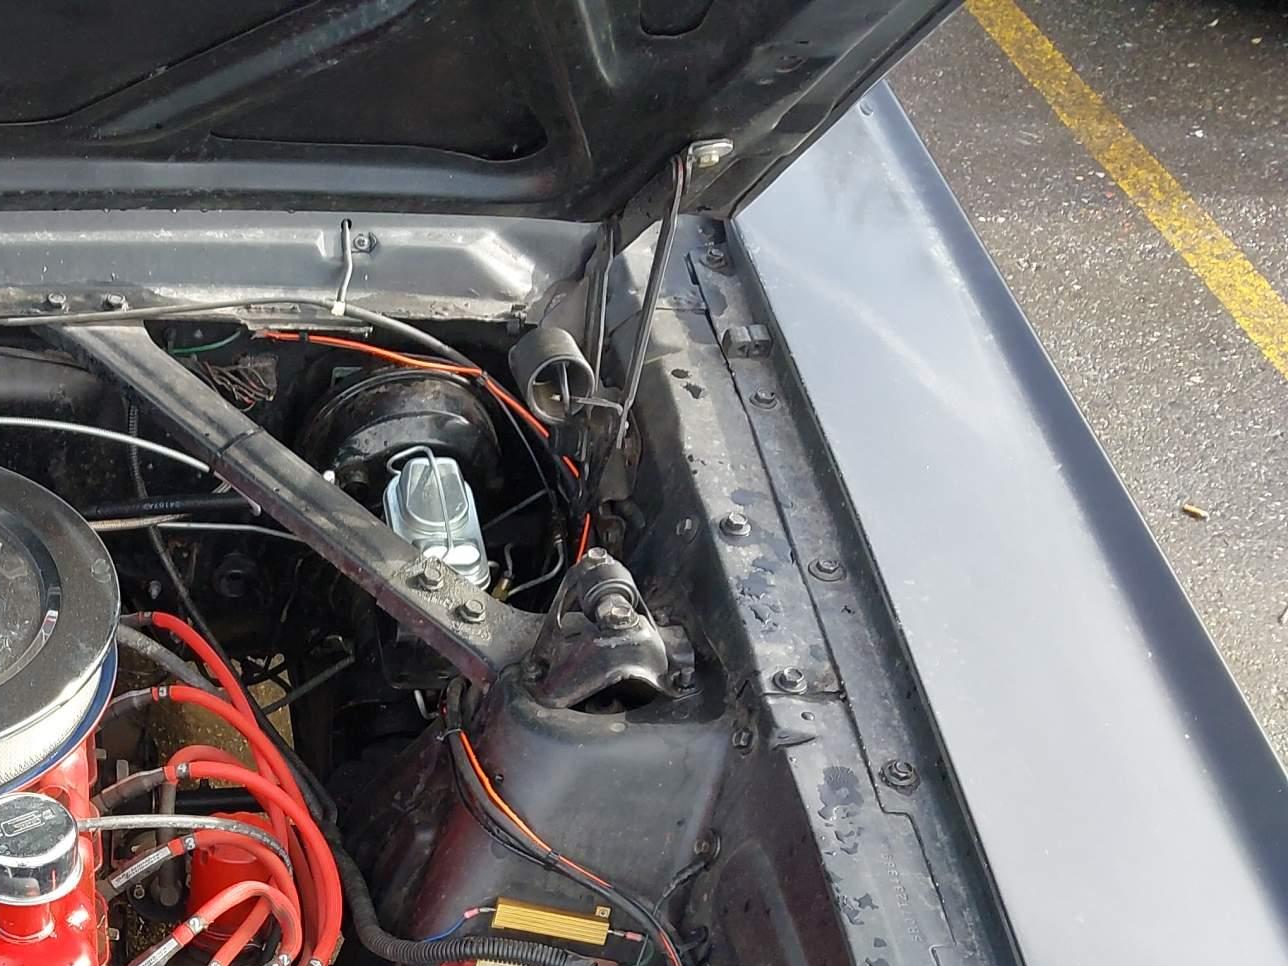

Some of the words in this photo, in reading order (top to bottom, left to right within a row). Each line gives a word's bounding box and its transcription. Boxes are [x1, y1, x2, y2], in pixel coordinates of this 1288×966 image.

[185, 837, 196, 850] 3
[189, 917, 203, 932] 2
[278, 953, 291, 966] 2
